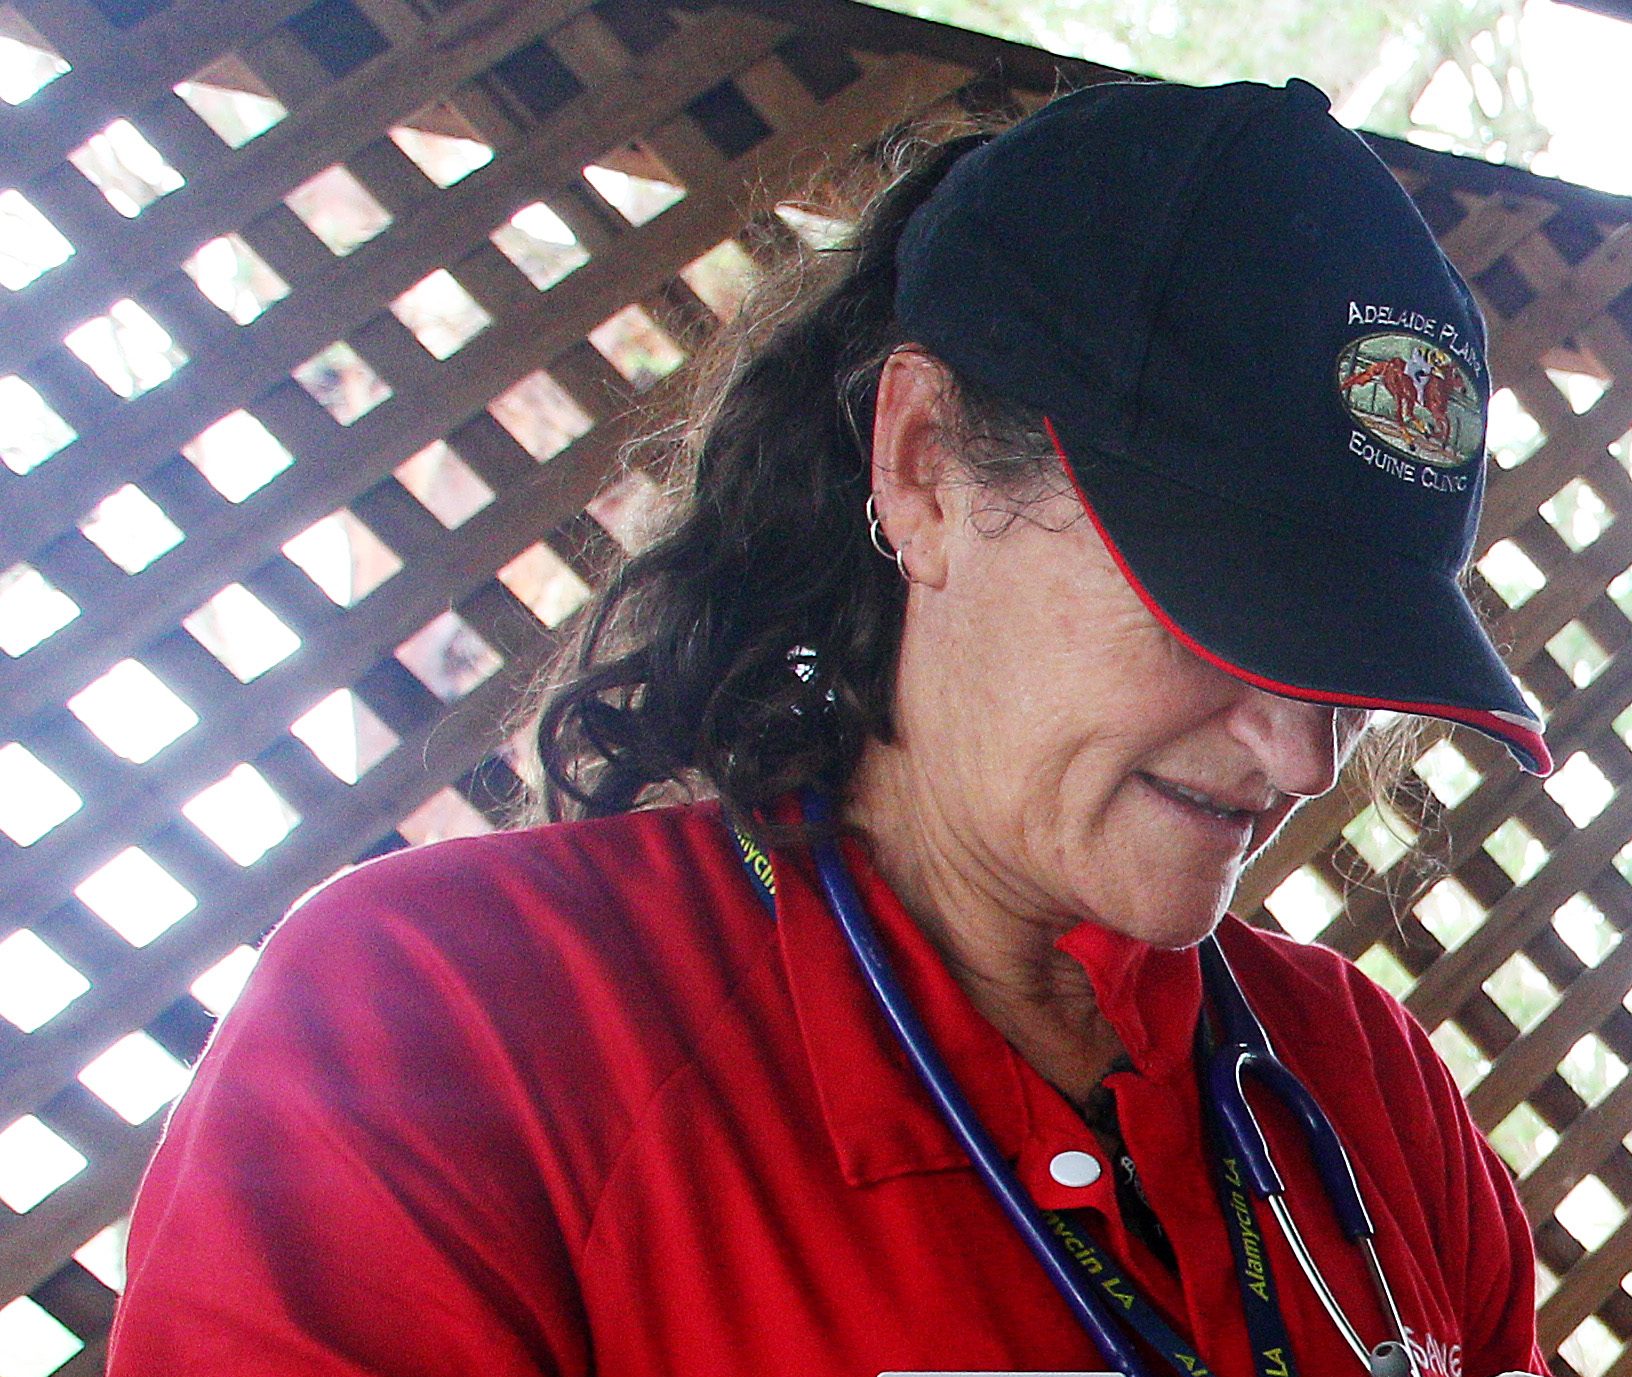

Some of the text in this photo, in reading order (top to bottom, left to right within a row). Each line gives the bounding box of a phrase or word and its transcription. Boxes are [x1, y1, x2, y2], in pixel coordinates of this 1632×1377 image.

[1348, 301, 1437, 337] ADELAIDE
[1350, 430, 1415, 483] EQUINE
[1222, 1157, 1269, 1302] Alamycin LA
[1101, 1278, 1135, 1310] LA
[1262, 1347, 1289, 1377] LA
